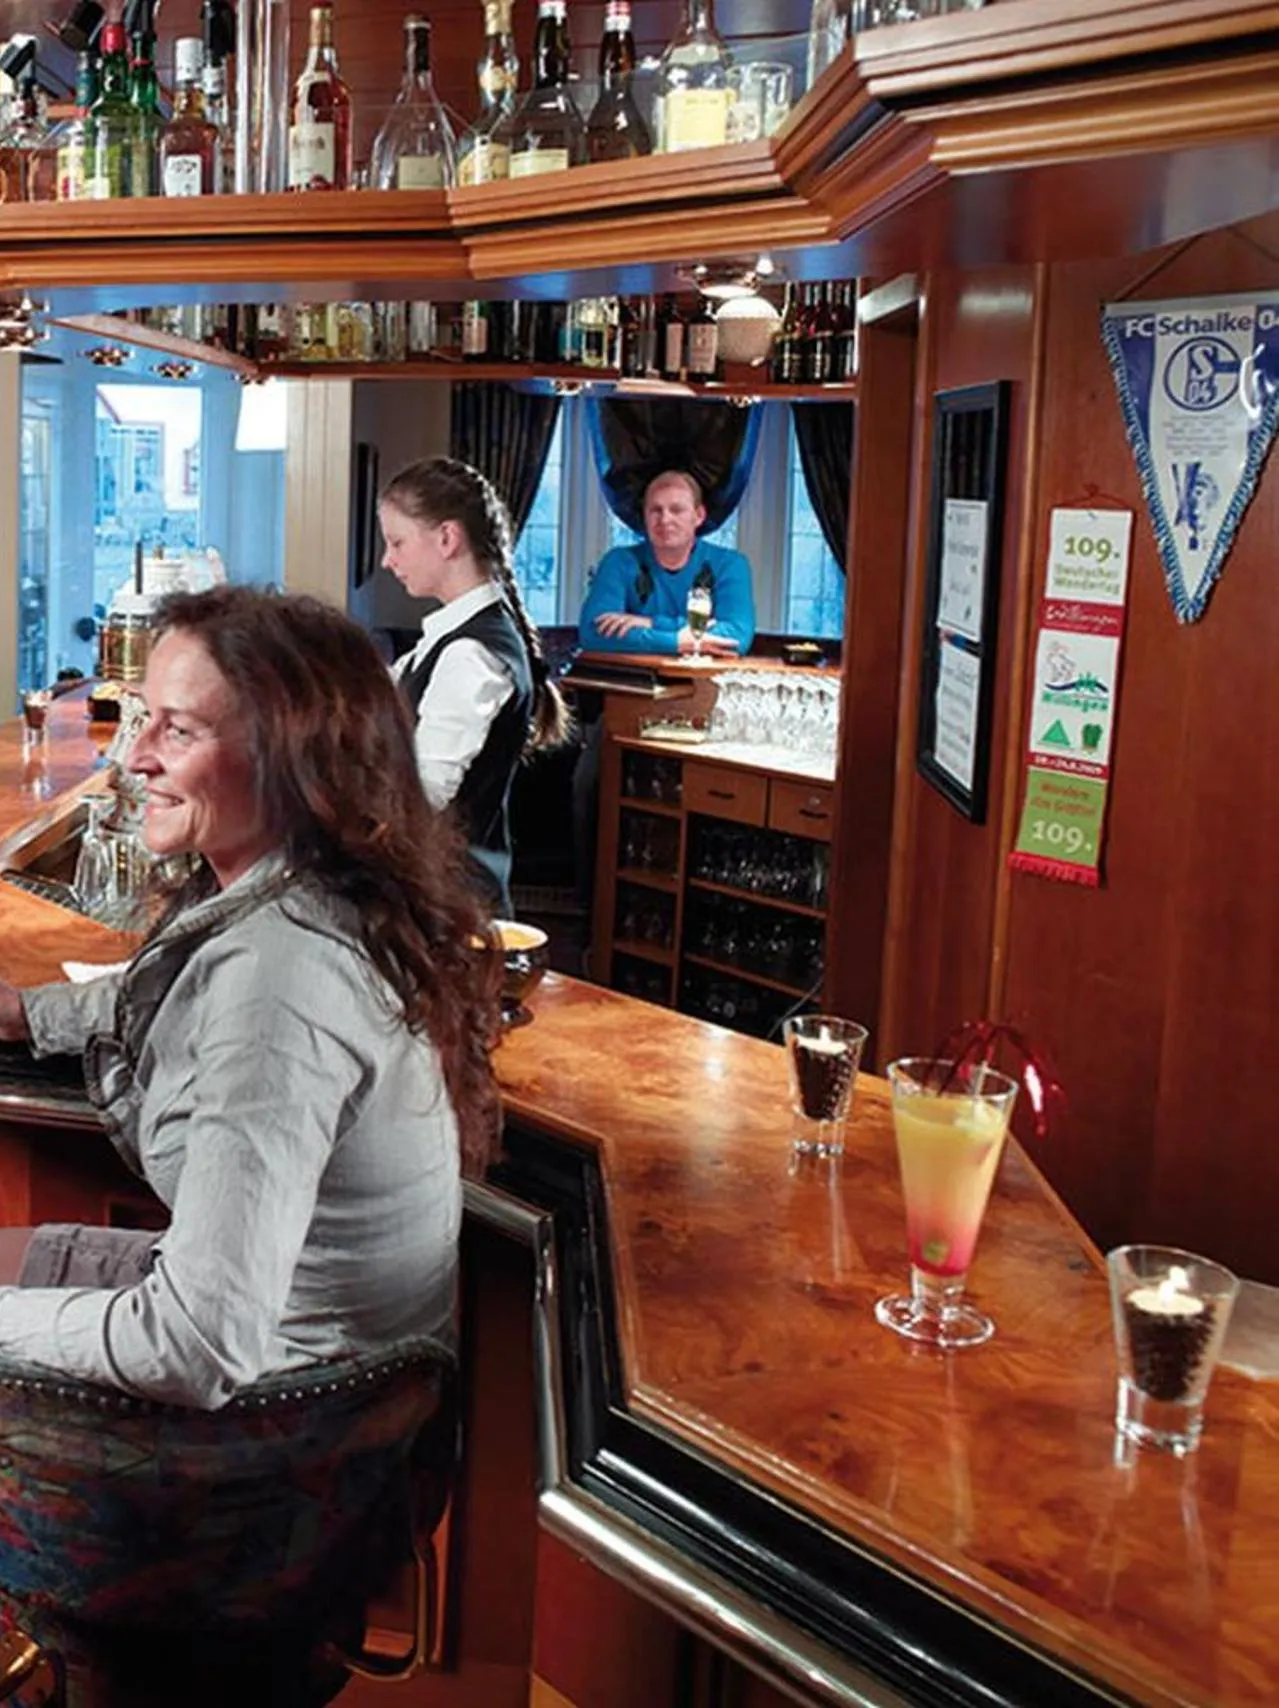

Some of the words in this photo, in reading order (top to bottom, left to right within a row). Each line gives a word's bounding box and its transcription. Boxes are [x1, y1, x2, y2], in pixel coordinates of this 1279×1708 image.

[1125, 317, 1154, 338] FC
[1158, 312, 1252, 336] Schalke
[1258, 308, 1279, 330] 0
[1063, 536, 1121, 563] 109.
[1031, 819, 1093, 854] 109.
